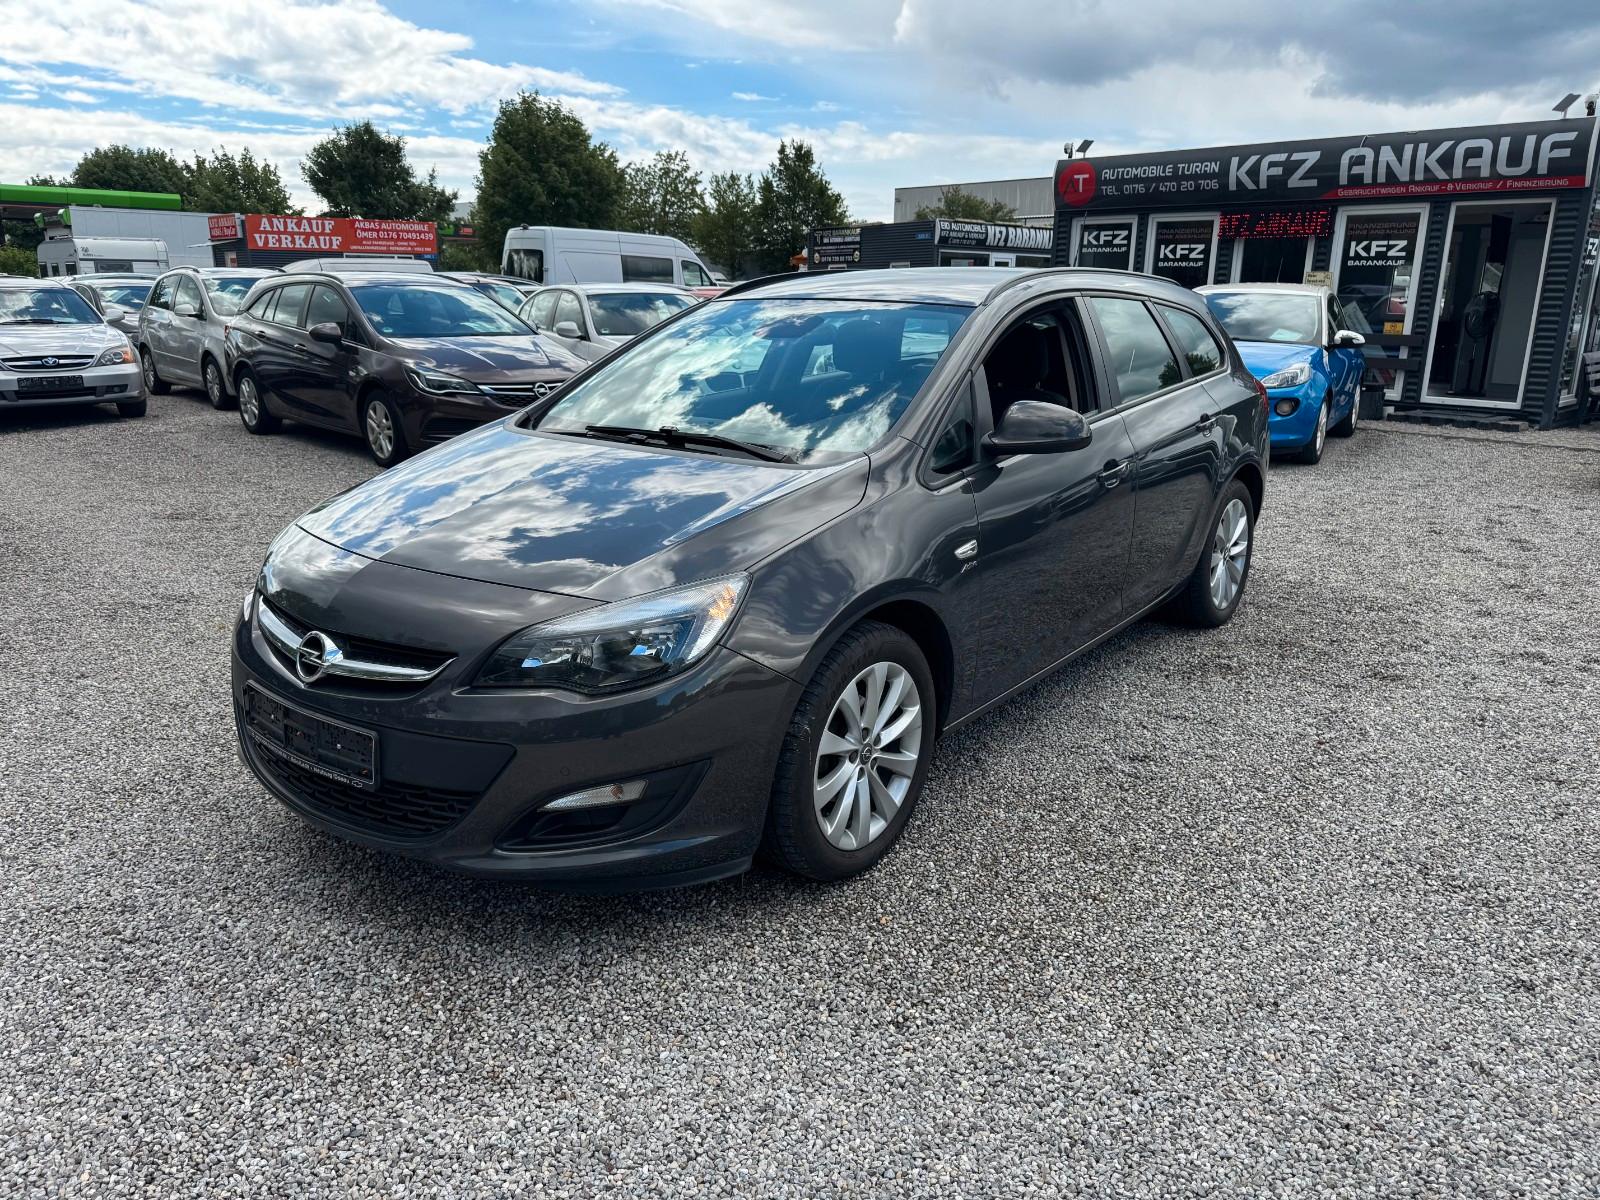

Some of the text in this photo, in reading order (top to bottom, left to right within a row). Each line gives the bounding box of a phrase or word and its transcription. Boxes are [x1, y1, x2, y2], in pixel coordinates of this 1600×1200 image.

[1229, 131, 1580, 191] KFZ ANKAUF
[1101, 161, 1220, 180] AUTOMOBILE TURAN
[1101, 185, 1121, 196] TEL.
[1123, 183, 1145, 194] 0176
[1159, 181, 1177, 192] 470
[1180, 180, 1195, 191] 20
[1199, 179, 1219, 190] 706
[259, 217, 335, 233] ANKAUF
[355, 221, 429, 231] AKBAS AUTOMOBILE
[951, 222, 986, 232] AUTOMOBILE
[253, 233, 342, 249] VERKAUF
[356, 229, 434, 240] ÖMER 0176 70491439
[1083, 230, 1129, 245] KFZ
[1160, 244, 1205, 259] KFZ
[1349, 240, 1408, 257] KFZ
